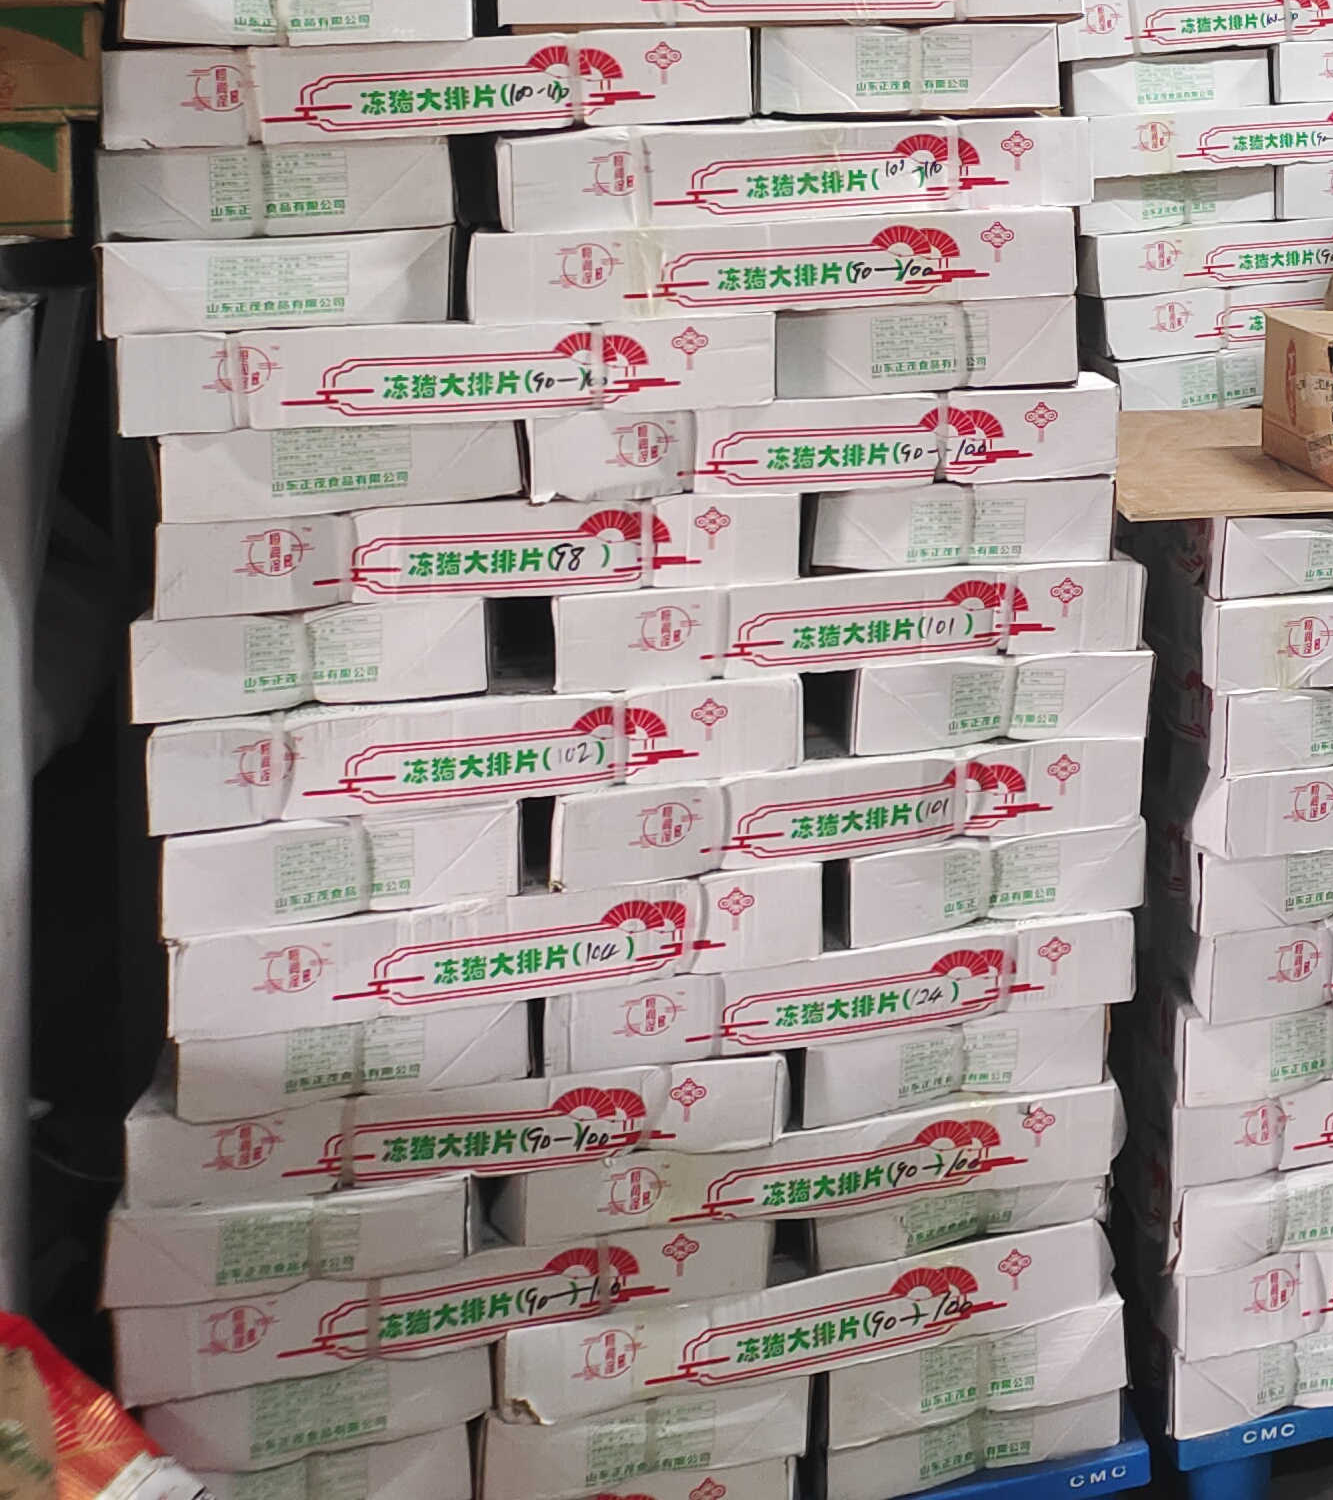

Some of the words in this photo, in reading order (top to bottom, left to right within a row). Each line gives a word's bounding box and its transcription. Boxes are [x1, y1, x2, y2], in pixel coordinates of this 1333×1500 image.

[210, 199, 346, 217] 山东正食品有限公司
[1243, 1422, 1296, 1445] CMC
[1069, 1463, 1128, 1490] CMC
